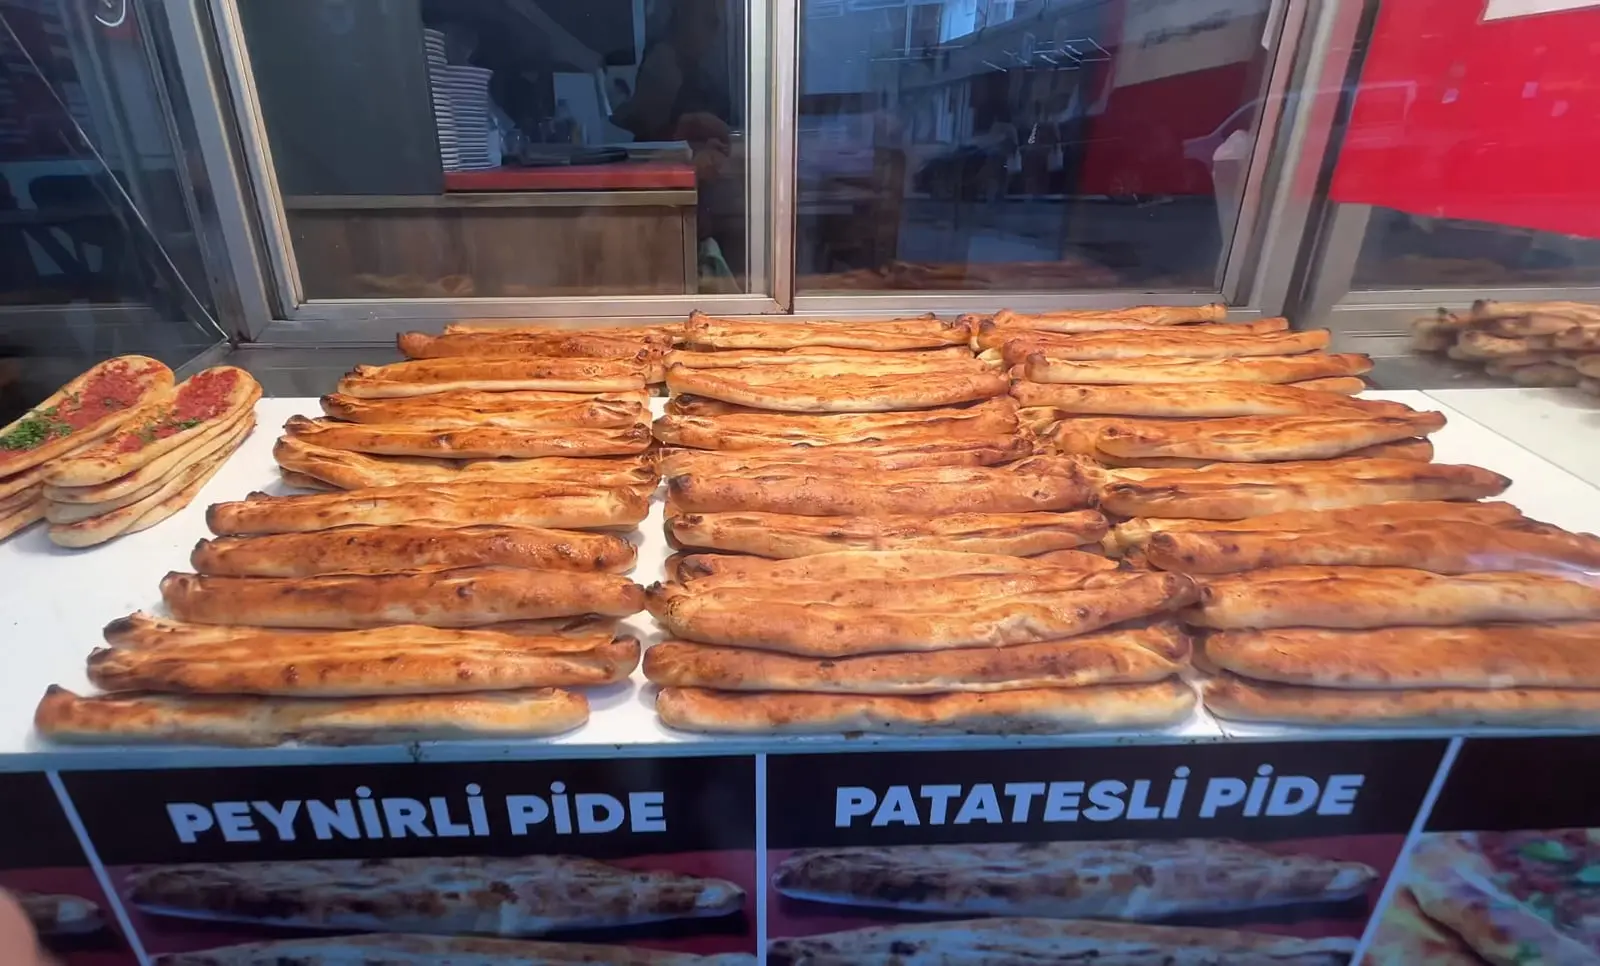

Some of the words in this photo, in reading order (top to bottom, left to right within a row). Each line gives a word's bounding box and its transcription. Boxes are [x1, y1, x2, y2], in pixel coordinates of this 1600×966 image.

[167, 783, 490, 843] PEYNİRLİ
[507, 781, 667, 835] PİDE
[835, 766, 1191, 828] PATATESLİ
[1199, 763, 1365, 819] PİDE
